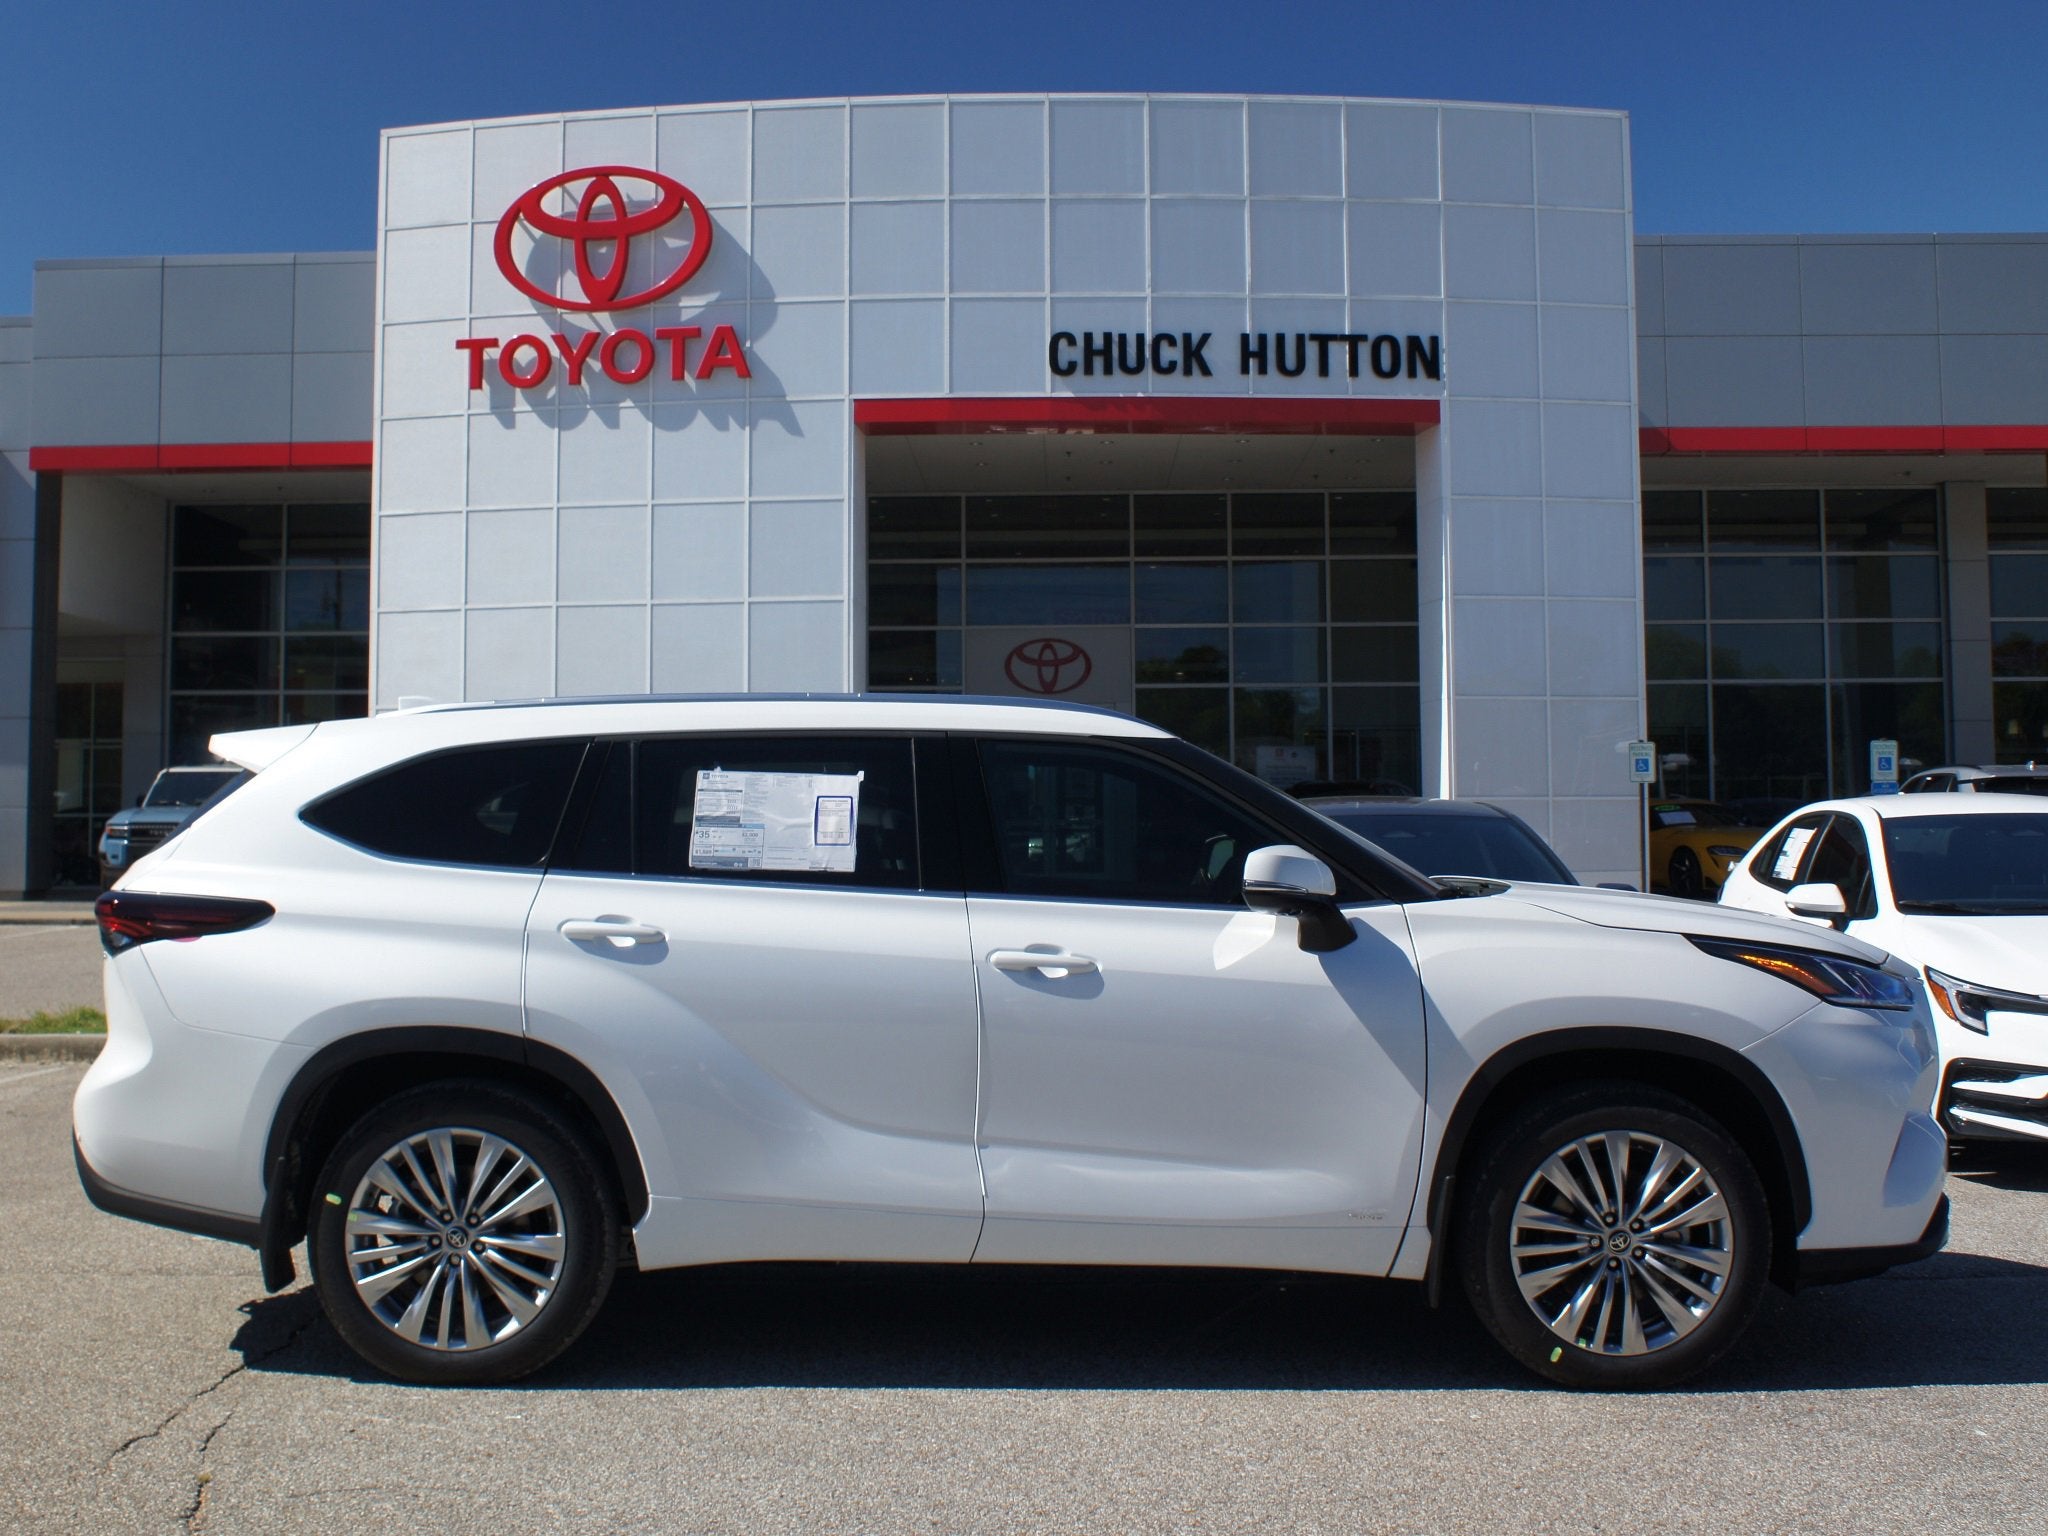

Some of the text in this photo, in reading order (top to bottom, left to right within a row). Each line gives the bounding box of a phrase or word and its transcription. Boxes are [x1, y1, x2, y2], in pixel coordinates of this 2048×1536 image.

[456, 324, 752, 391] TOYOTA
[1048, 331, 1441, 381] CHUCK HUTTON
